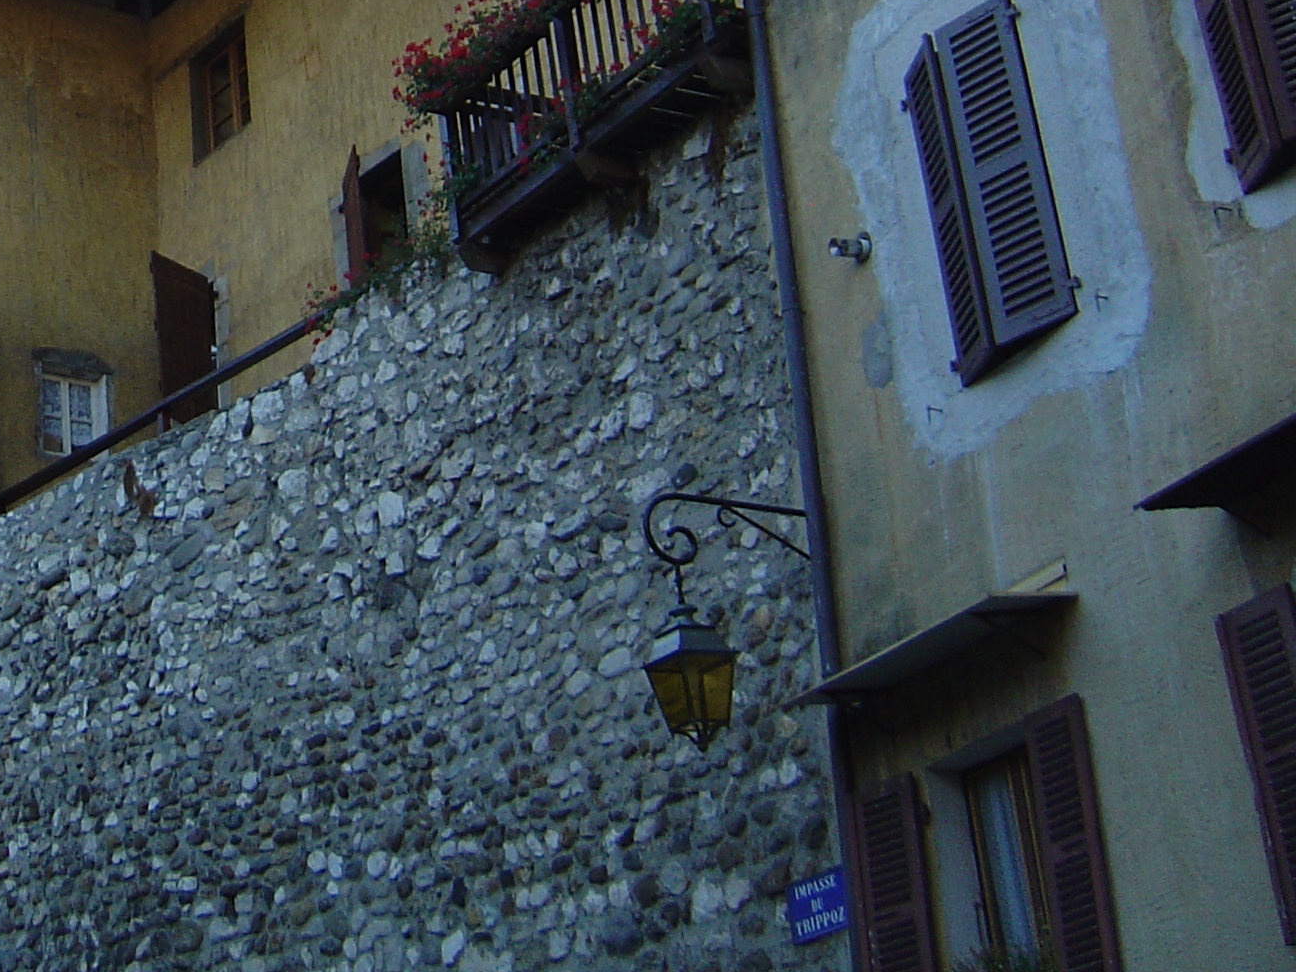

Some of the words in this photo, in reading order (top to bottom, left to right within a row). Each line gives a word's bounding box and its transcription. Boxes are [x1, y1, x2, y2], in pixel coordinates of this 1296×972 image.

[794, 874, 836, 900] IMPASSE
[810, 897, 824, 913] DU
[795, 906, 845, 936] TRIPPOZ
